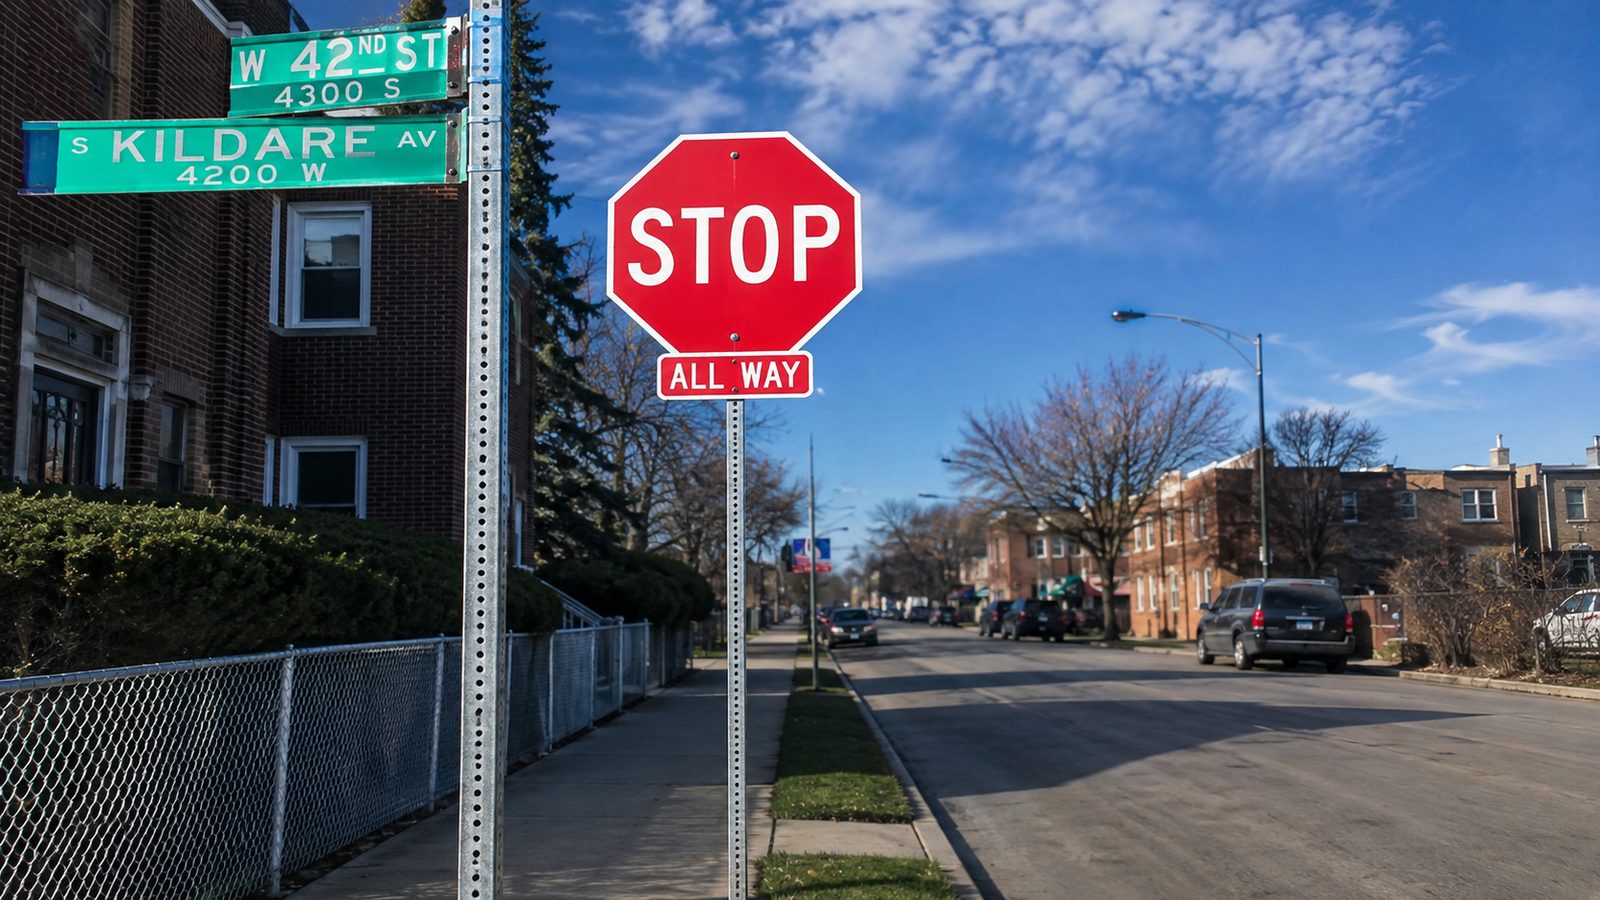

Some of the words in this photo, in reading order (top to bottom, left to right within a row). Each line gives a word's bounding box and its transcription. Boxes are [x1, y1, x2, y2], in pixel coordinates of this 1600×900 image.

[239, 49, 265, 82] W
[395, 33, 441, 71] ST
[274, 80, 363, 108] 4300
[384, 77, 400, 99] S
[71, 137, 89, 155] S
[112, 125, 376, 163] KILDARE
[397, 130, 437, 148] AV
[176, 164, 278, 185] 4200
[301, 163, 327, 182] W
[627, 204, 841, 287] STOP
[669, 362, 725, 390] ALL
[740, 360, 800, 389] WAY
